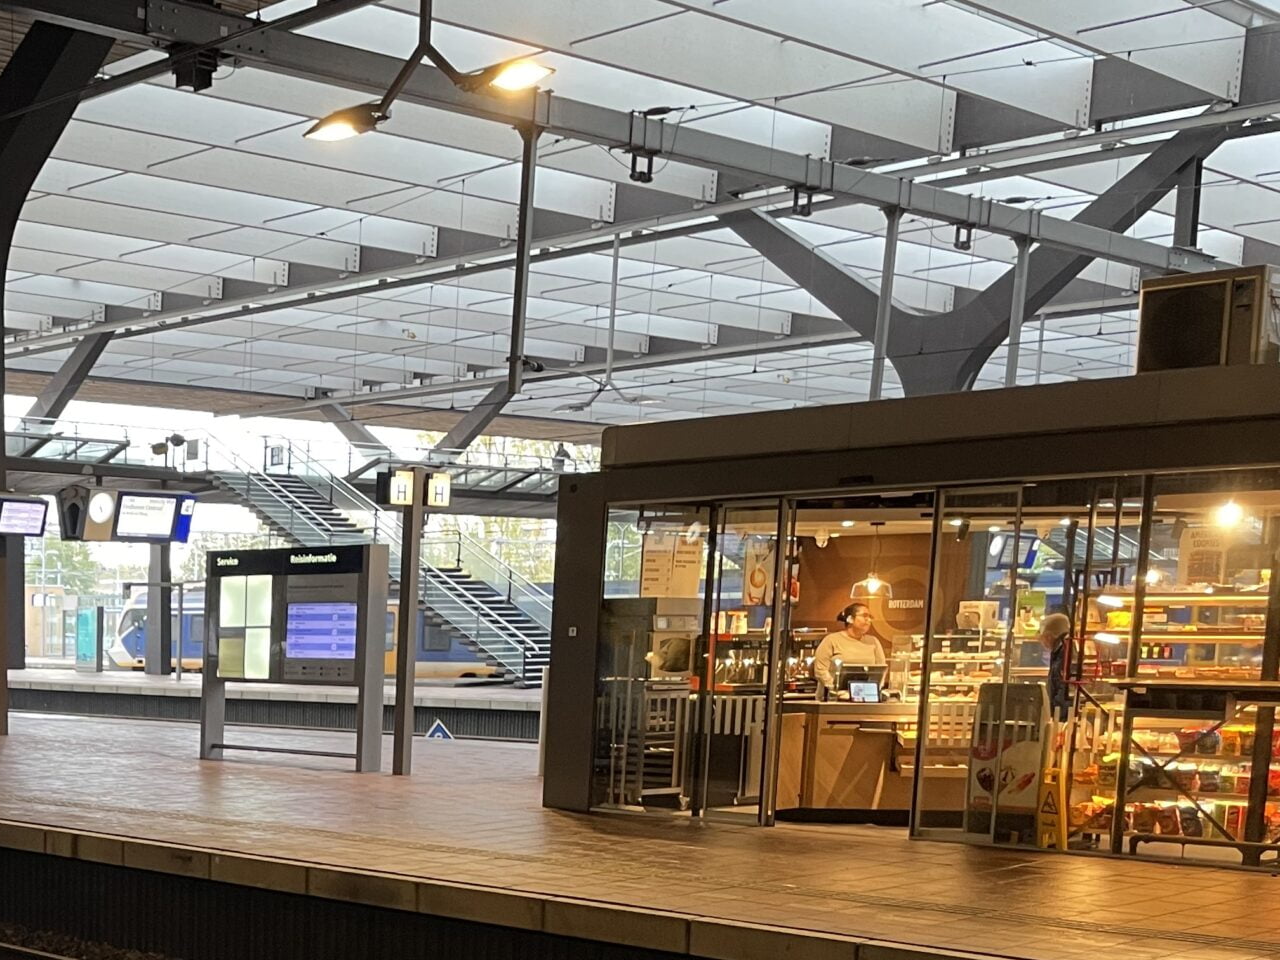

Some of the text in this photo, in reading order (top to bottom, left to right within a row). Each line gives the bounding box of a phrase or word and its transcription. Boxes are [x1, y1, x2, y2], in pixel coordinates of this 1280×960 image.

[397, 484, 407, 501] H
[434, 485, 444, 503] H
[217, 556, 239, 567] Service
[888, 599, 924, 609] ROTTERDAM
